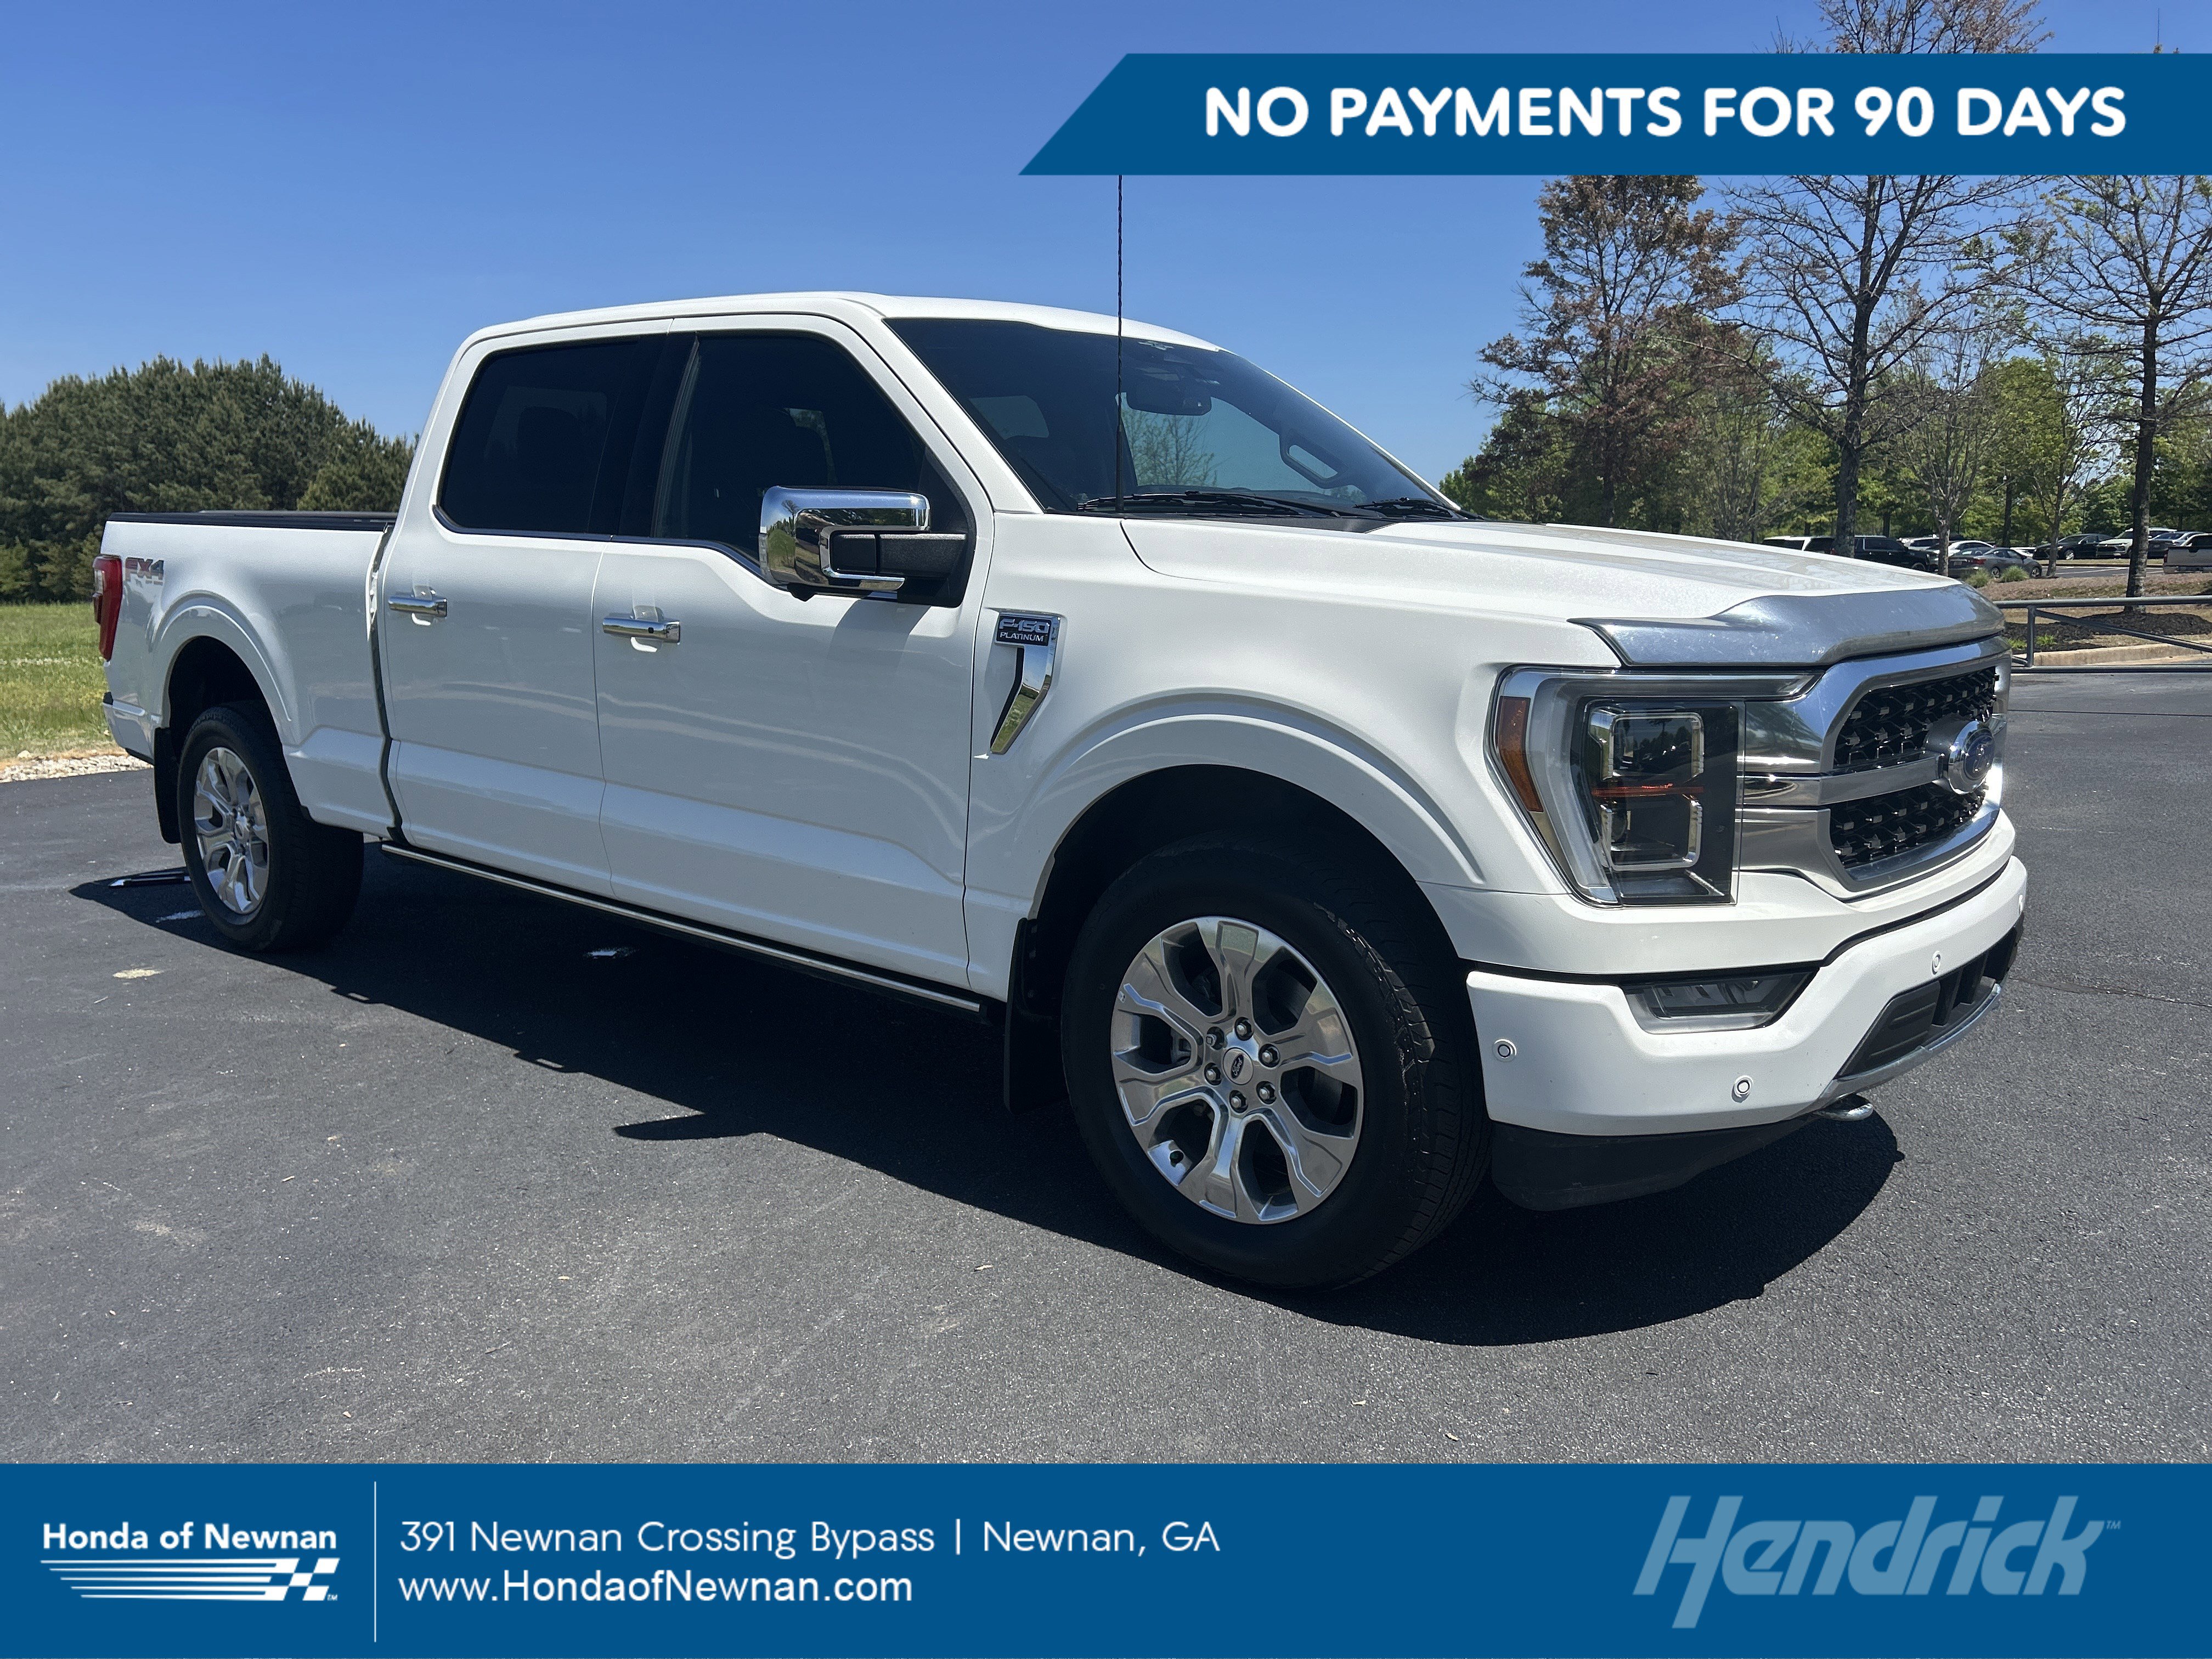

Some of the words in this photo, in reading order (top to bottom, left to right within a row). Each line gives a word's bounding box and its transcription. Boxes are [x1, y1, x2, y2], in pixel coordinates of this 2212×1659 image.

[125, 557, 164, 582] FX4
[999, 618, 1050, 634] F-150
[1000, 631, 1044, 642] PLATINUM
